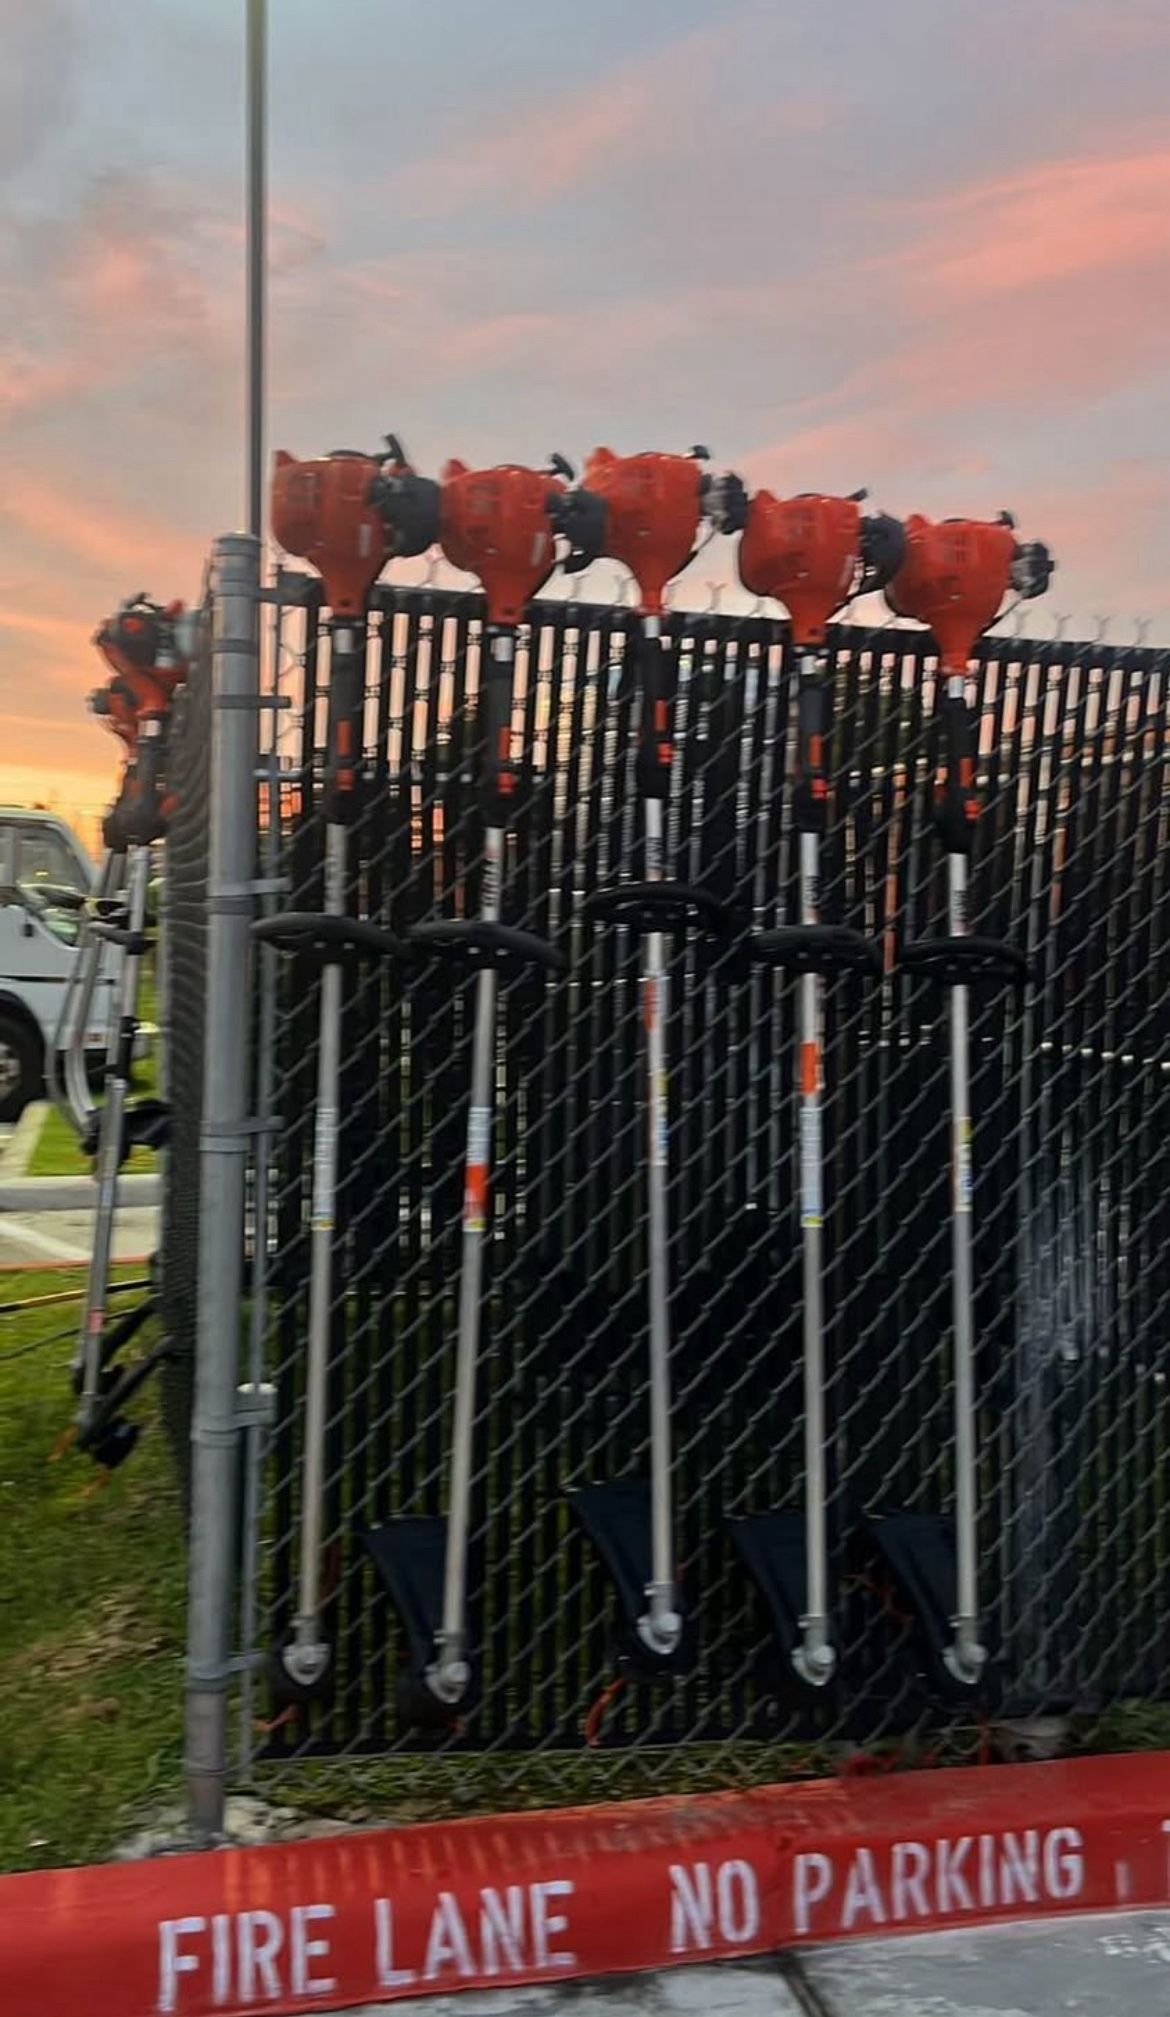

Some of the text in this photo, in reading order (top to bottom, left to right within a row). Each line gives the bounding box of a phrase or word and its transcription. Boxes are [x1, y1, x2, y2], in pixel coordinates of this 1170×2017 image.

[158, 1904, 336, 2012] FIRE
[374, 1880, 575, 1986] LANE
[668, 1860, 760, 1953] NO
[793, 1827, 1084, 1934] PARKING
